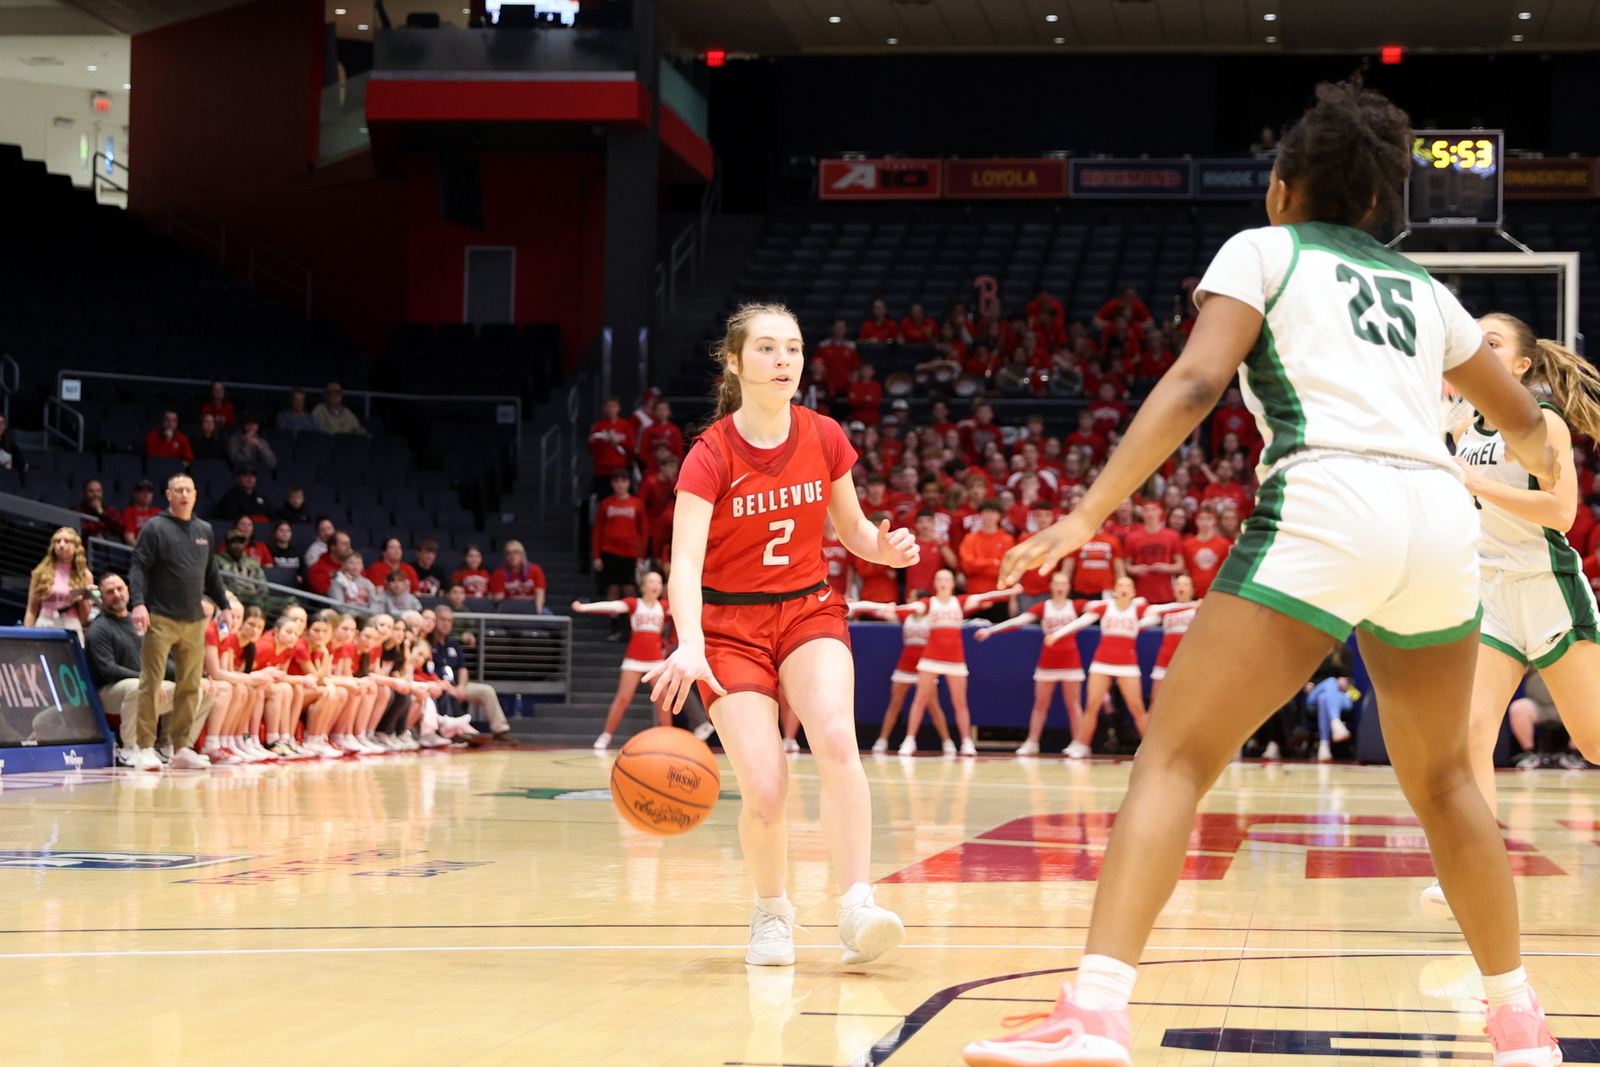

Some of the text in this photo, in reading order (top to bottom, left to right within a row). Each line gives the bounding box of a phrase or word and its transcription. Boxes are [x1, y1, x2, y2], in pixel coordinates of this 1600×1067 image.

[1431, 139, 1493, 169] 5:53
[972, 171, 1038, 187] LOYOLA
[1335, 263, 1417, 357] 25
[732, 480, 823, 518] BELLEVUE
[762, 518, 795, 566] 2
